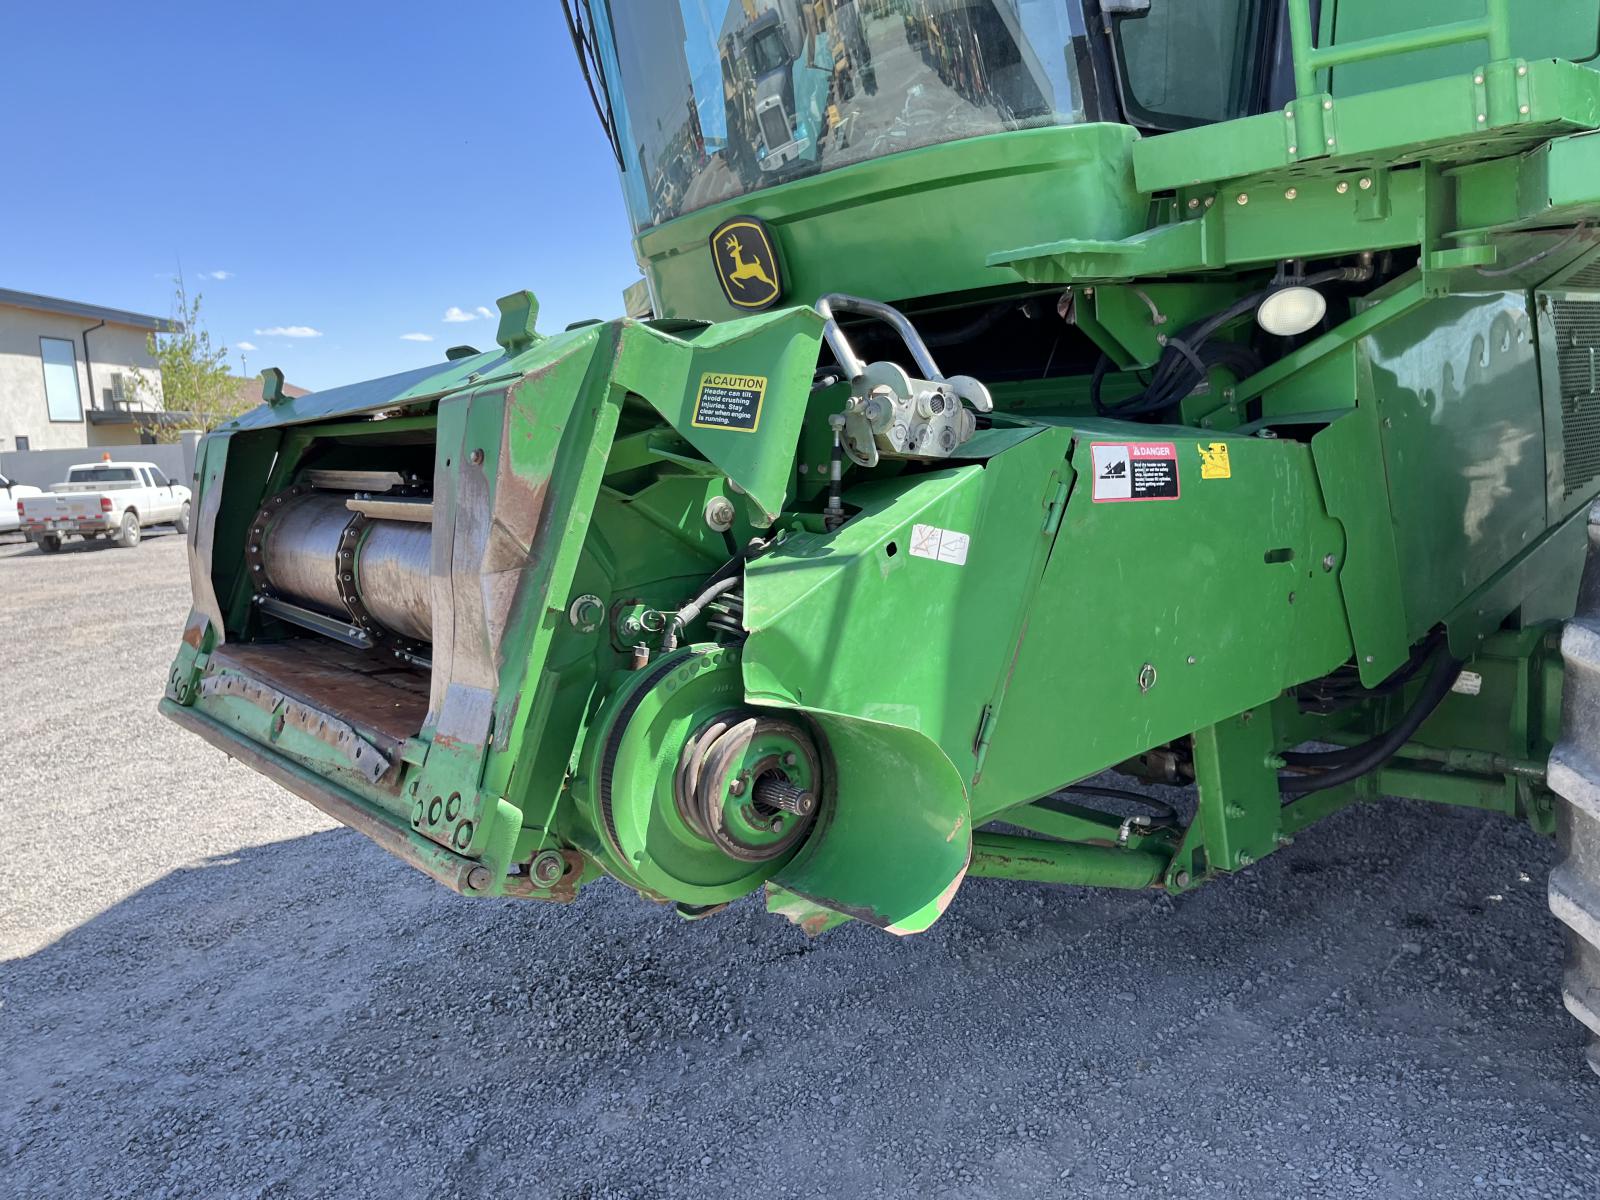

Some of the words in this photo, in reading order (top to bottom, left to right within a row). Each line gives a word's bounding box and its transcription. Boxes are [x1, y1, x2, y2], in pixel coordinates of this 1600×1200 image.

[713, 375, 764, 389] CAUTION
[704, 387, 727, 396] Header
[702, 394, 721, 402] Avoid
[722, 396, 750, 406] crushing
[701, 401, 727, 410] injuries.
[728, 403, 743, 412] Stay
[731, 411, 751, 420] engine
[705, 416, 730, 425] running.
[1140, 447, 1170, 456] DANGER
